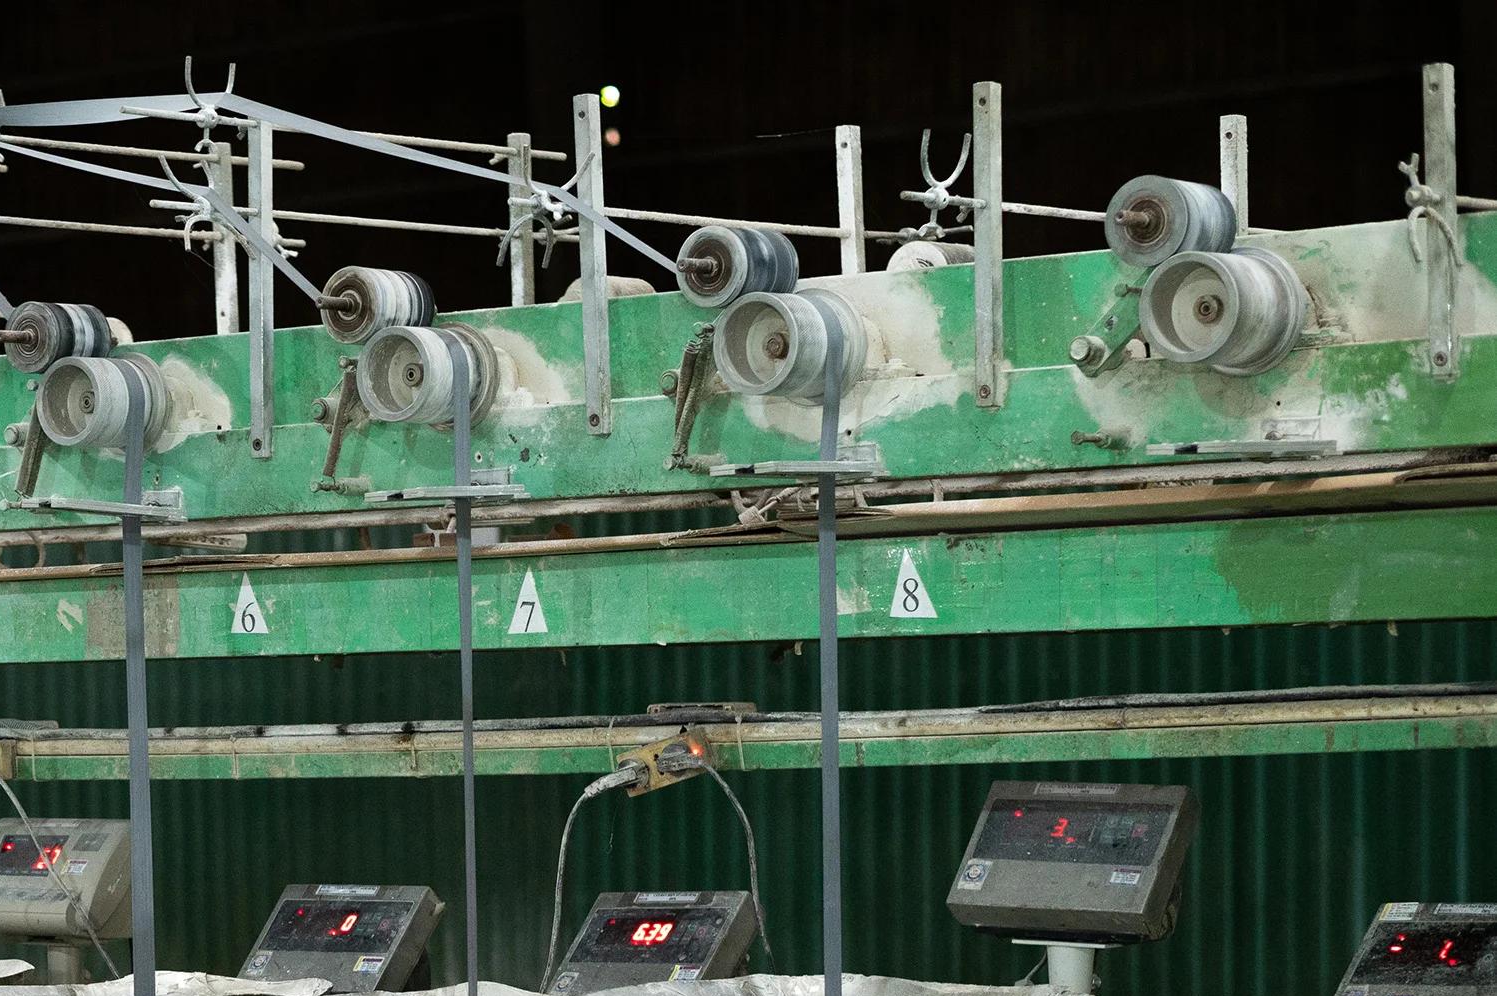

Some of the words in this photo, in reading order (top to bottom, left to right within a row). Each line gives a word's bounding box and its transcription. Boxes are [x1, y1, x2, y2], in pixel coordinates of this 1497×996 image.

[903, 578, 919, 613] 8
[242, 603, 256, 632] 6
[519, 602, 535, 632] 7
